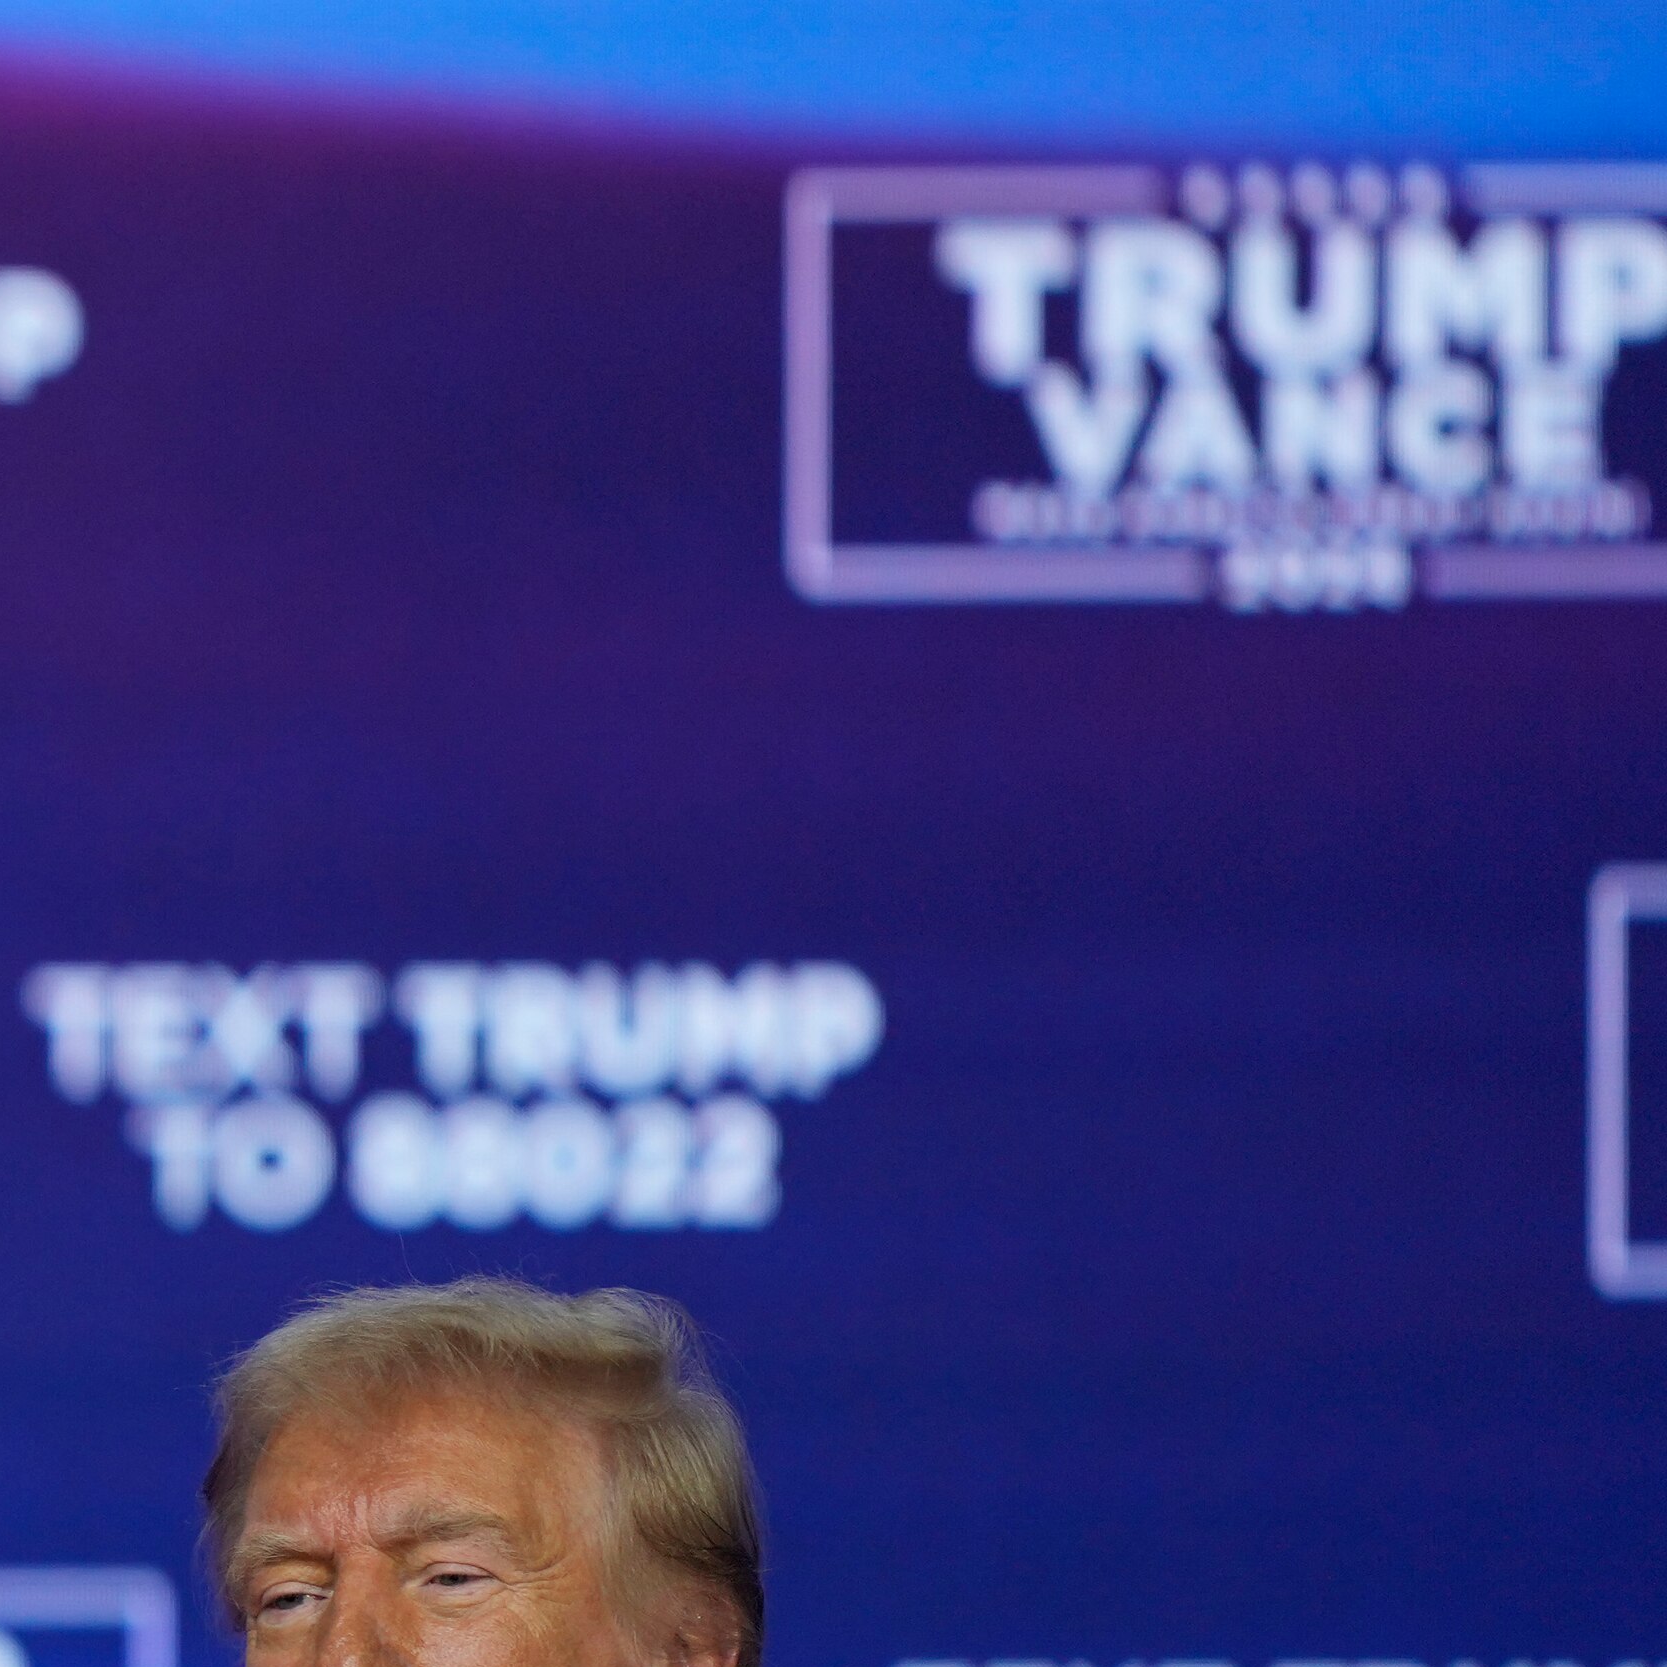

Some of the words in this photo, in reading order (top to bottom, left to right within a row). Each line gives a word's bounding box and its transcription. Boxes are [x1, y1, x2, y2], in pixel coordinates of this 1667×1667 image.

[1026, 362, 1607, 496] VANCE
[23, 961, 383, 1103] TEXT
[394, 959, 884, 1100] TRUMP
[125, 1091, 334, 1232] TO
[349, 1091, 781, 1230] 88022
